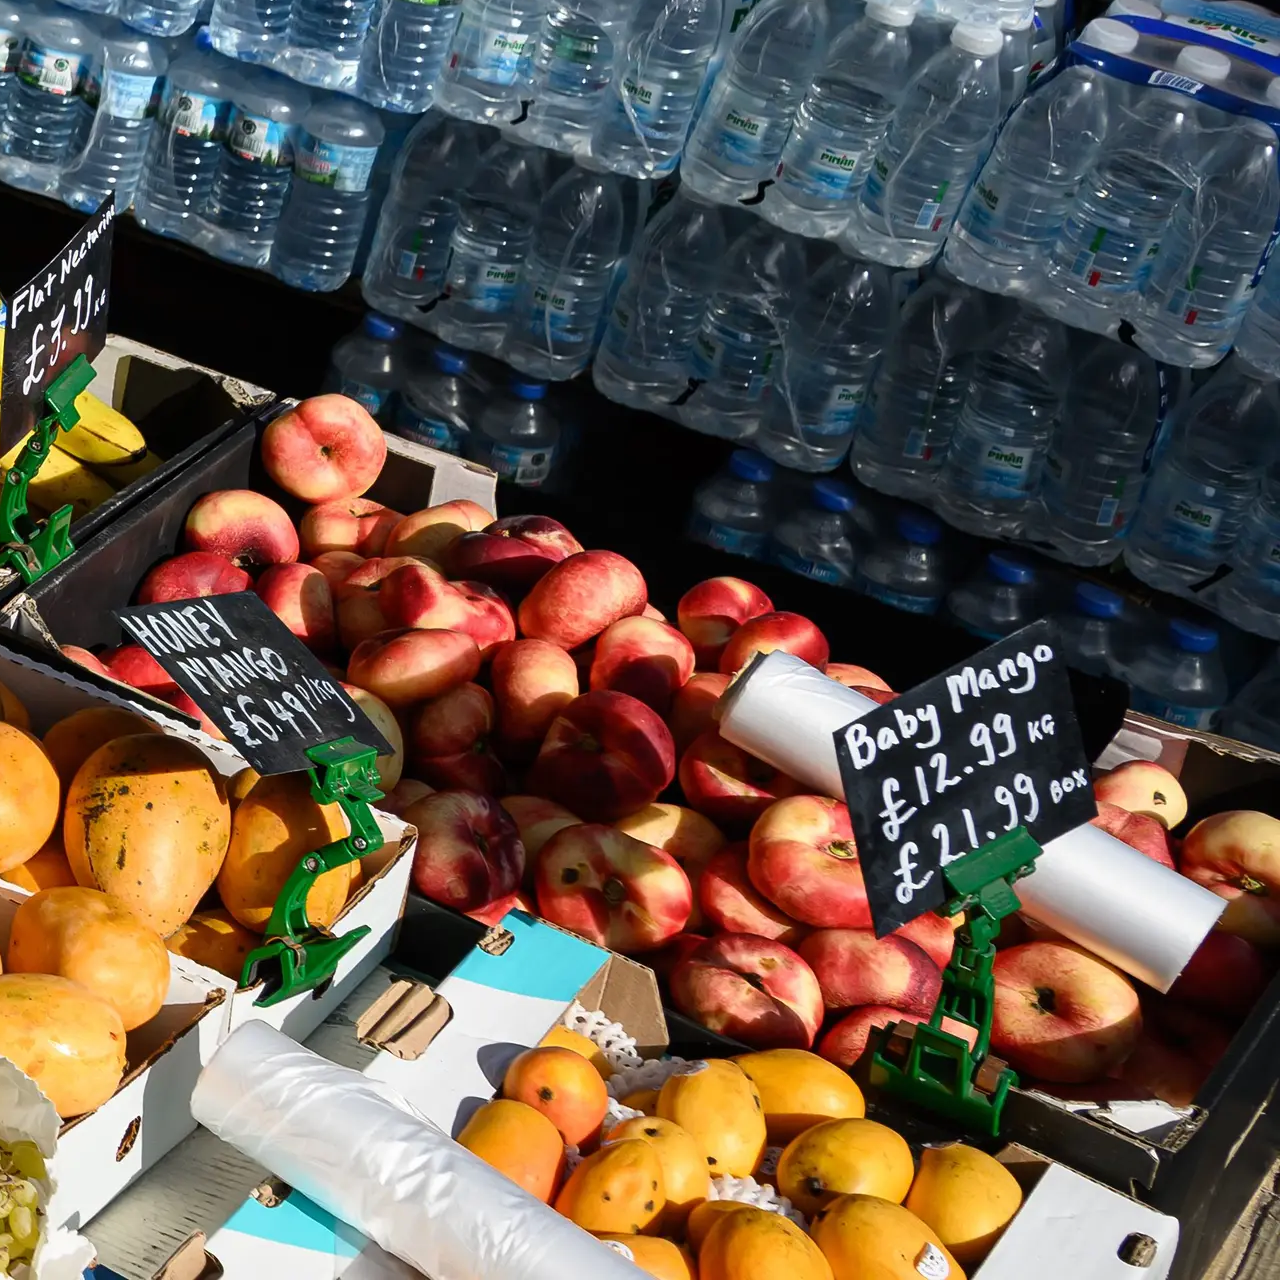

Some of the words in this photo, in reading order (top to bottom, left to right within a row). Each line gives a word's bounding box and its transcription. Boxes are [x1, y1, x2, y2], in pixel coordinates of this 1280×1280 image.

[820, 152, 856, 172] PINAR
[10, 272, 57, 330] Flat
[22, 273, 95, 397] £3.99
[119, 598, 239, 658] HONEY
[176, 646, 289, 697] MANGO
[844, 703, 942, 770] Baby
[946, 644, 1054, 714] Mango
[877, 711, 1018, 843] £12.99
[1027, 713, 1056, 744] KG
[892, 772, 1040, 905] £21.99
[1048, 767, 1089, 804] BOX
